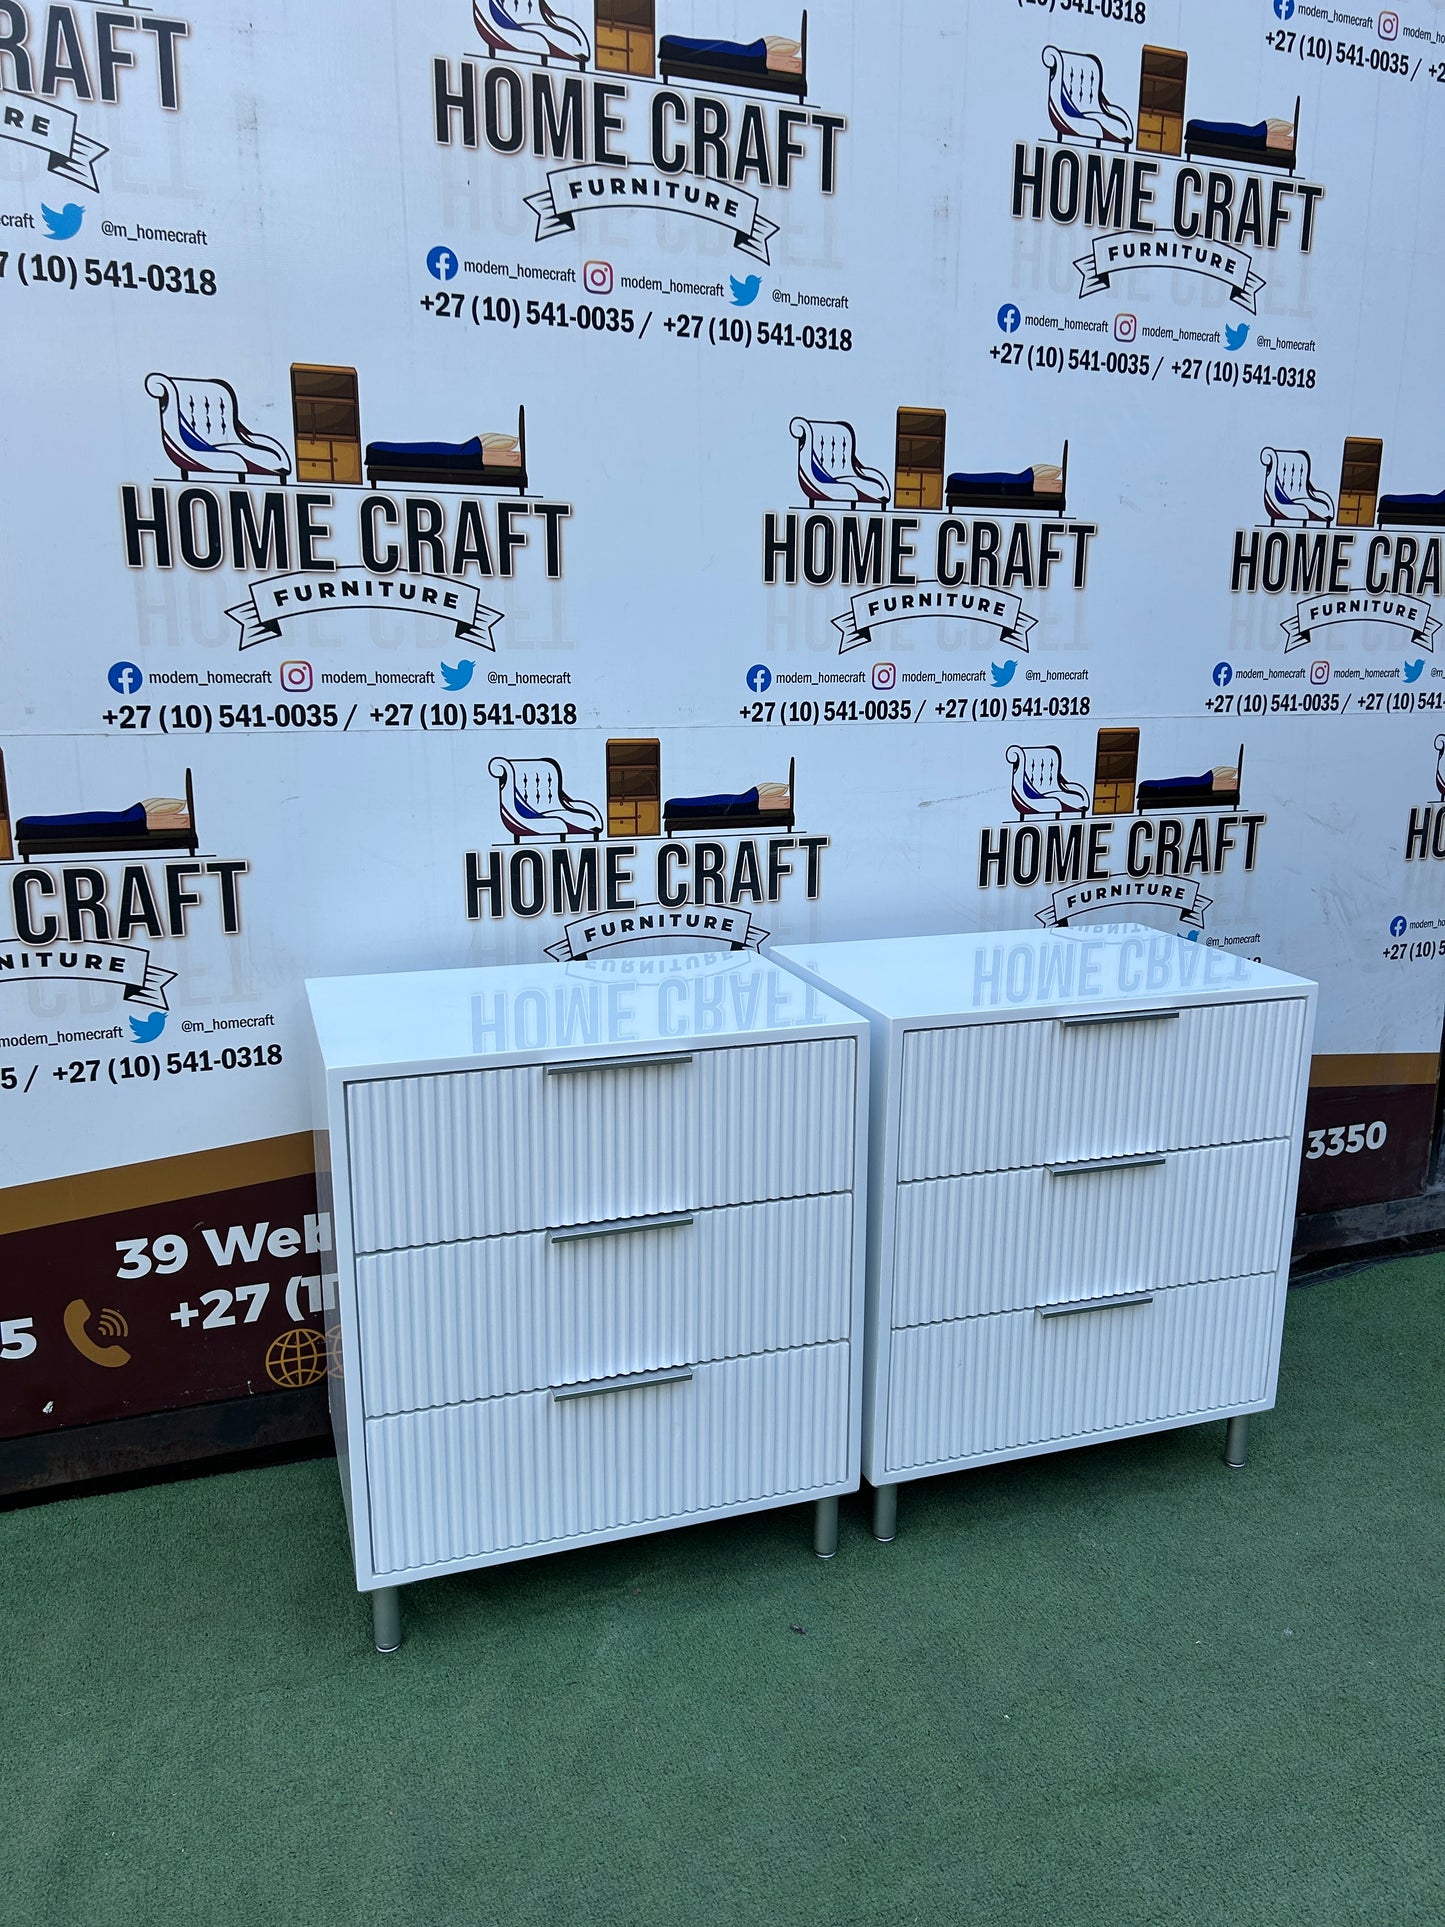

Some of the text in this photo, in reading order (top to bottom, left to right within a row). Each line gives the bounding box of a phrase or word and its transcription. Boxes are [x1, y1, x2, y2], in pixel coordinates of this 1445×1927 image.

[1265, 29, 1297, 53] +27
[1299, 34, 1333, 66] (10)
[1335, 41, 1409, 76] 541-0035
[3, 105, 51, 137] RE
[433, 58, 845, 195] HOME CRAFT
[569, 178, 739, 219] FURNITURE
[1012, 143, 1324, 253] HOME CRAFT
[101, 220, 208, 246] @m_homecraft
[17, 252, 78, 290] (10)
[84, 258, 217, 296] 541-0318
[1108, 243, 1238, 275] FURNITURE
[772, 289, 849, 309] @m_homecraft
[420, 291, 465, 318] +27
[471, 295, 521, 329] (10)
[526, 300, 635, 333] 541-0035
[663, 313, 704, 339] +27
[708, 317, 752, 349] (10)
[756, 321, 853, 352] 541-0318
[1256, 335, 1316, 352] @m_homecraft
[989, 342, 1024, 365] +27
[1027, 344, 1064, 374] (10)
[1067, 348, 1150, 376] 541-0035
[1171, 358, 1203, 380] +27
[1205, 360, 1239, 388] (10)
[1242, 363, 1316, 389] 541-0318
[121, 485, 571, 579] HOME CRAFT
[763, 513, 1096, 588] HOME CRAFT
[1231, 530, 1442, 595] HOME CRA
[273, 579, 459, 609] FURNITURE
[867, 593, 1005, 616] FURNITURE
[1310, 600, 1418, 621] FURNITURE
[487, 671, 572, 687] @m_homecraft
[1025, 669, 1089, 683] @m_homecraft
[102, 705, 152, 729] +27
[159, 704, 213, 734] (10)
[219, 703, 338, 728] 541-0035
[369, 703, 414, 726] +27
[420, 703, 467, 731] (10)
[472, 703, 577, 726] 541-0318
[739, 701, 776, 723] +27
[780, 701, 820, 727] (10)
[823, 699, 912, 722] 541-0035
[934, 698, 969, 719] +27
[971, 697, 1008, 722] (10)
[1011, 696, 1091, 718] 541-0318
[1204, 694, 1235, 713] +27
[1236, 694, 1268, 717] (10)
[1270, 693, 1340, 713] 541-0035
[1357, 692, 1385, 711] +27
[1386, 692, 1415, 714] (10)
[978, 814, 1266, 887] HOME CRAFT
[465, 837, 829, 920] HOME CRAFT
[12, 860, 248, 946] CRAFT
[1067, 883, 1186, 909] FURNITURE
[584, 914, 734, 942] FURNITURE
[1205, 933, 1261, 948] @m_homecraft
[1382, 943, 1408, 961] +27
[1409, 940, 1436, 962] (10)
[181, 1013, 275, 1034] @m_homecraft
[52, 1059, 101, 1084] +27
[108, 1054, 161, 1085] (10)
[166, 1043, 283, 1075] 541-0318
[1305, 1120, 1388, 1160] 3350
[116, 1234, 188, 1279] 39
[170, 1283, 270, 1329] +27
